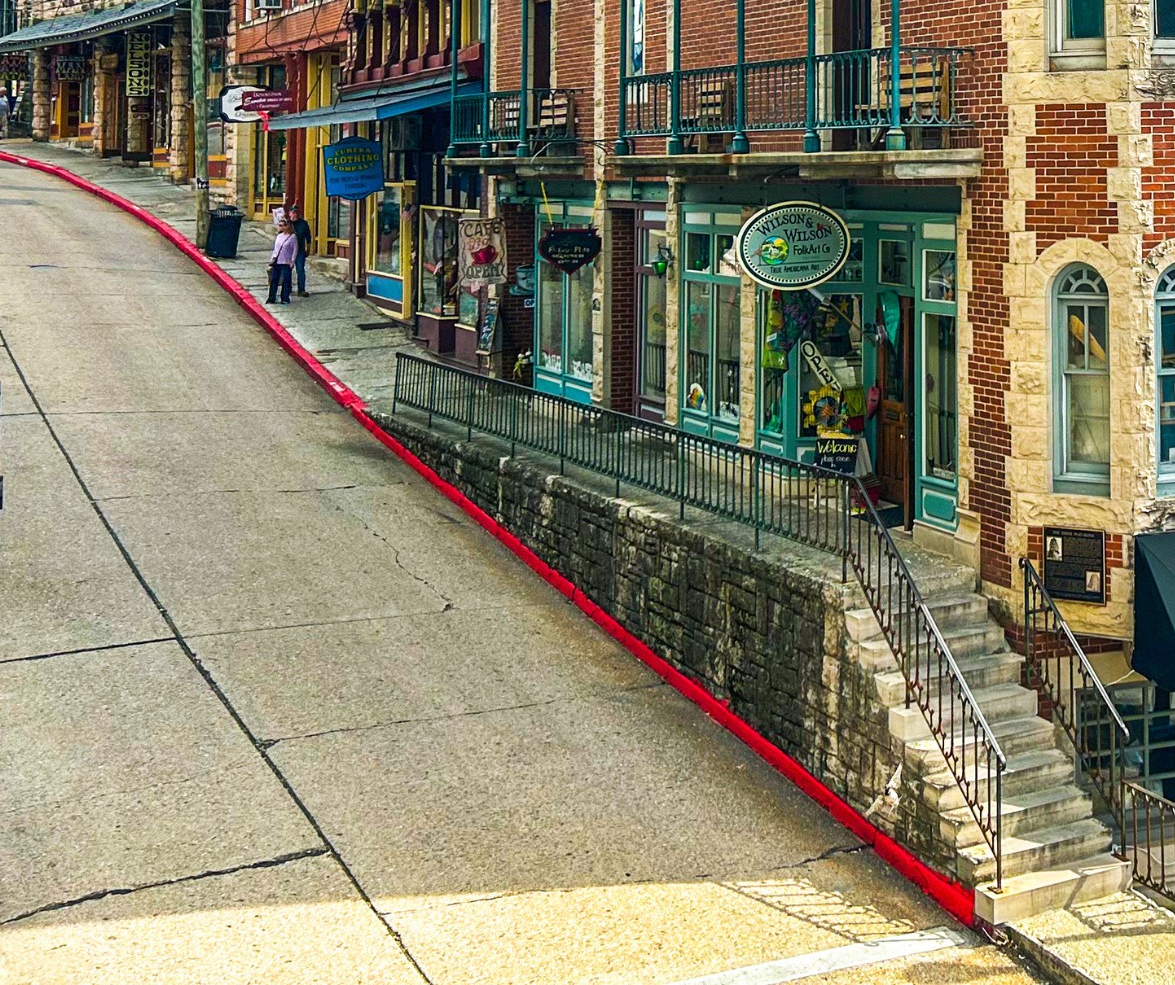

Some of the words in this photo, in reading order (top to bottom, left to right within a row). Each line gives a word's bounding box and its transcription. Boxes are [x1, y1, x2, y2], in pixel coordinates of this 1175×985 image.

[327, 153, 380, 165] CLOTHING
[333, 162, 376, 172] COMPANY
[756, 214, 805, 237] WILSON
[805, 217, 814, 229] &
[783, 225, 833, 244] WILSON
[784, 265, 810, 273] AMERICANA
